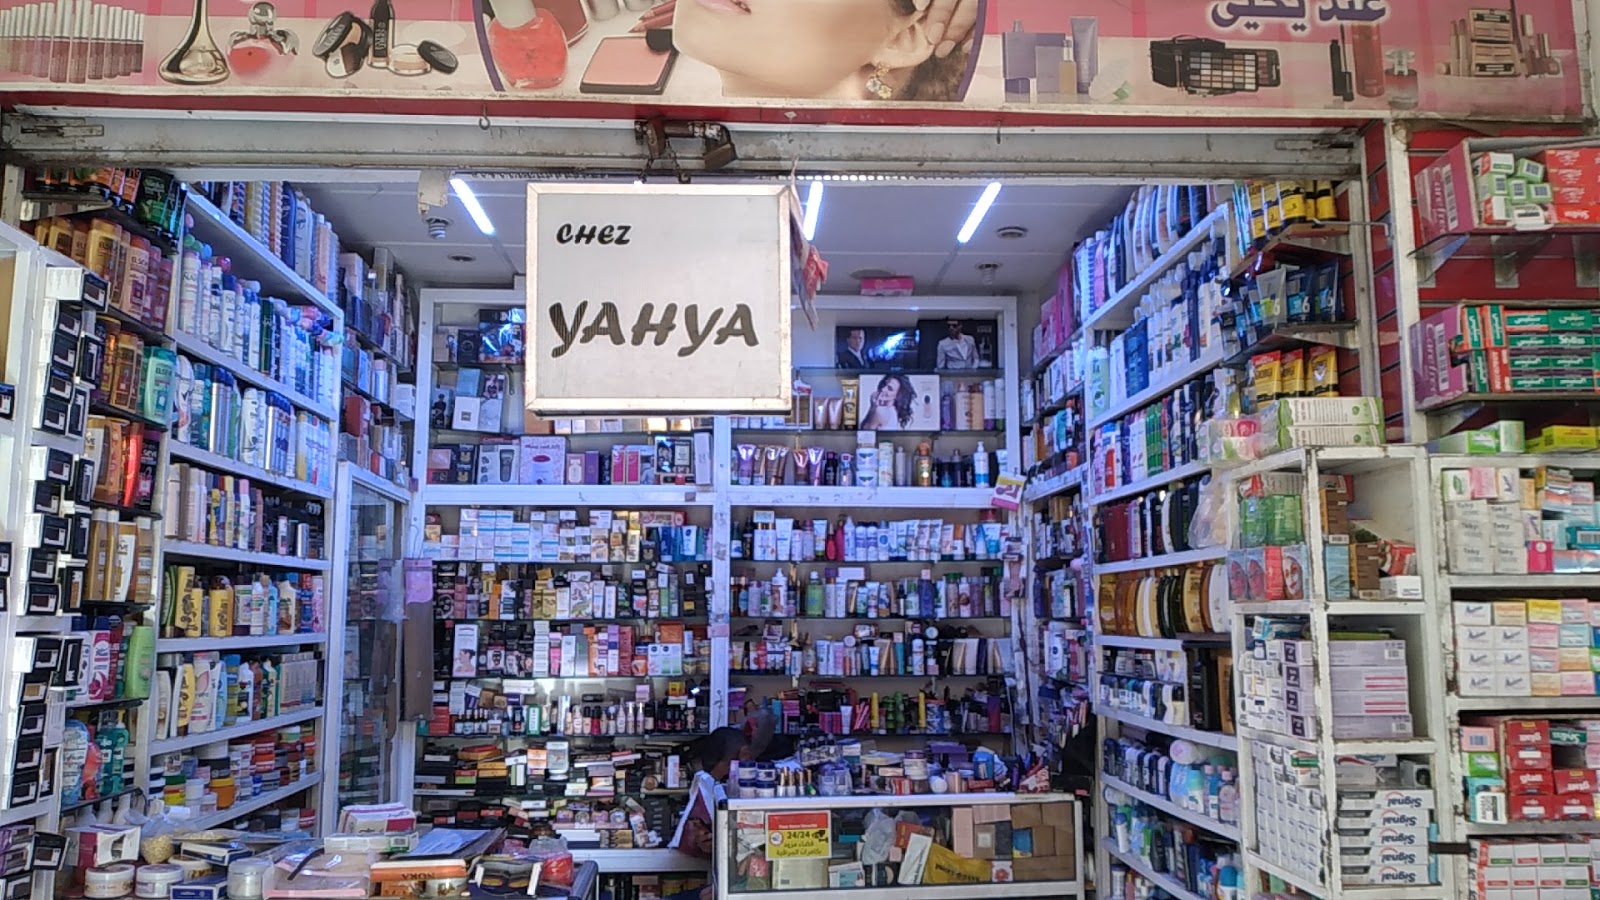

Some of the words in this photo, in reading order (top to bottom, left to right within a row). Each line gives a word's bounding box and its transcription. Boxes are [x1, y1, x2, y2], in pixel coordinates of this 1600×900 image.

[556, 223, 632, 245] CHEZ
[549, 300, 760, 358] YAHYA
[1387, 795, 1422, 808] Signal
[1382, 814, 1417, 827] Signal
[786, 831, 810, 839] 24/24
[1381, 833, 1415, 845] Signal
[1381, 852, 1416, 864] Signal
[1381, 871, 1416, 883] Signal
